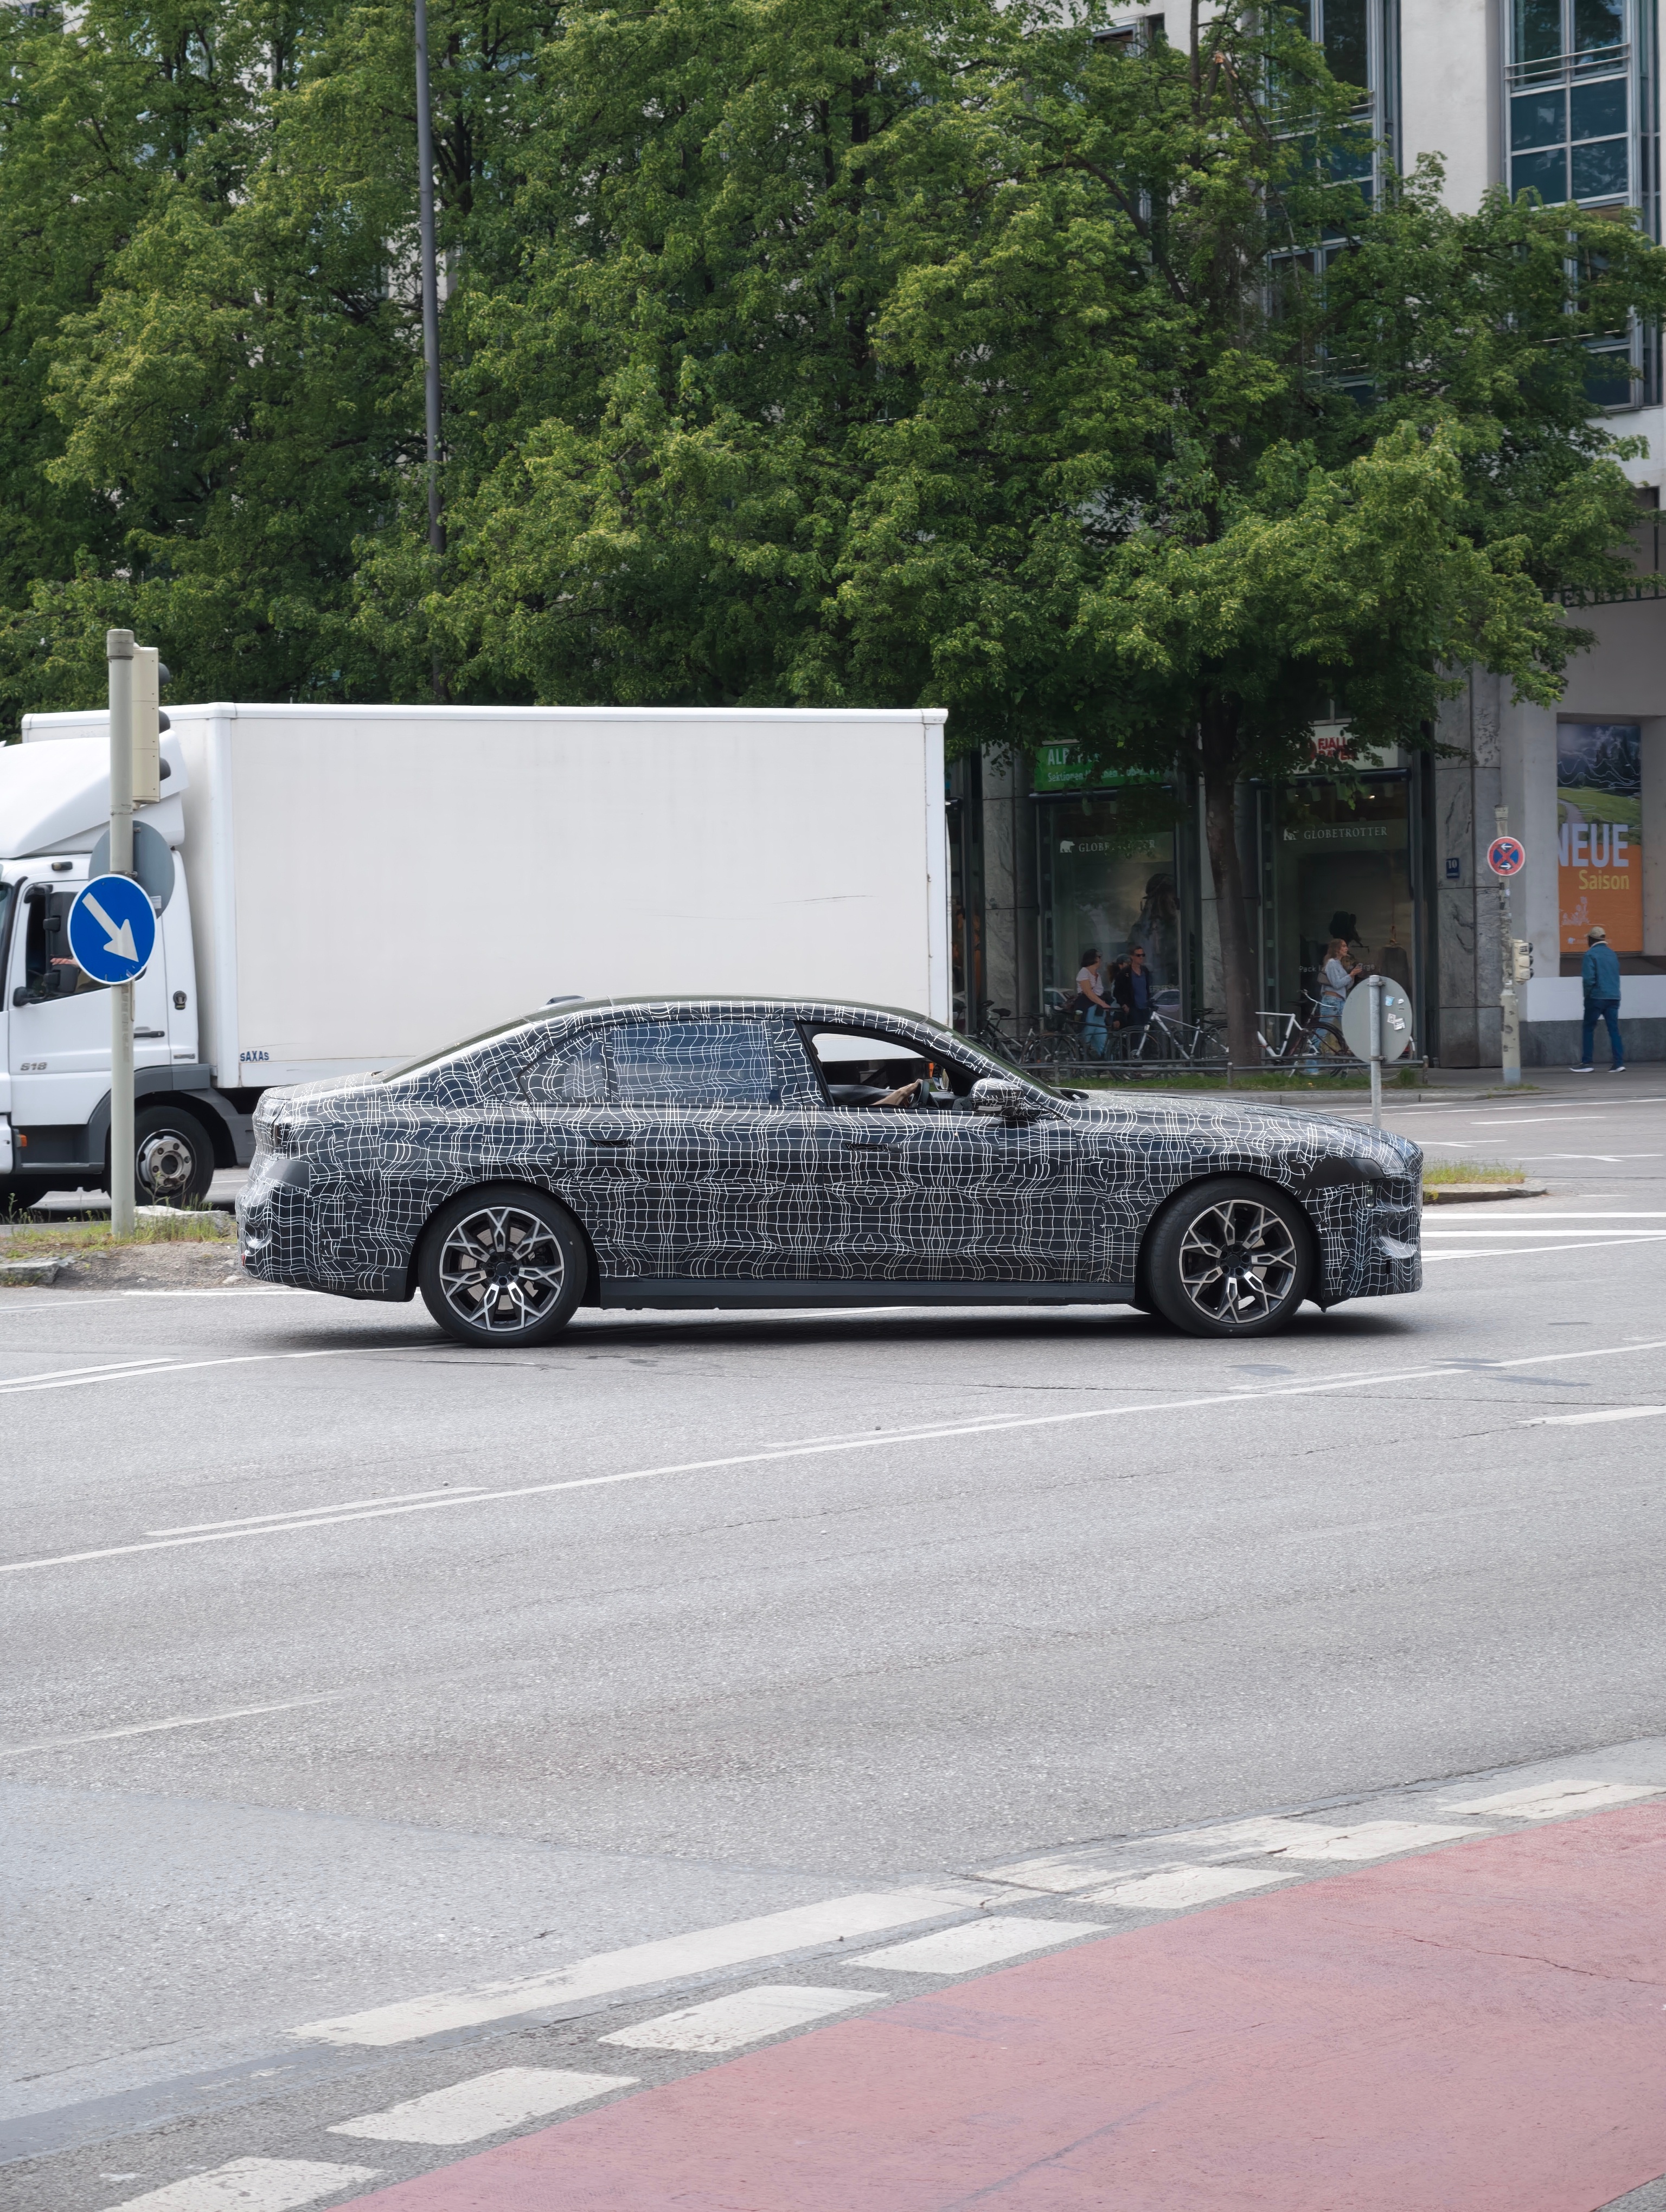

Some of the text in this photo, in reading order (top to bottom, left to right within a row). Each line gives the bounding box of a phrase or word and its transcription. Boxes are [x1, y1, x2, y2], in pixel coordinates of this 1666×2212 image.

[1304, 827, 1387, 840] GLOBETROTTER
[1078, 839, 1155, 852] GLOBER
[1558, 823, 1629, 867] NEUE
[1446, 859, 1457, 869] 10
[1579, 869, 1629, 890] Saison
[240, 1050, 270, 1062] SAXAS
